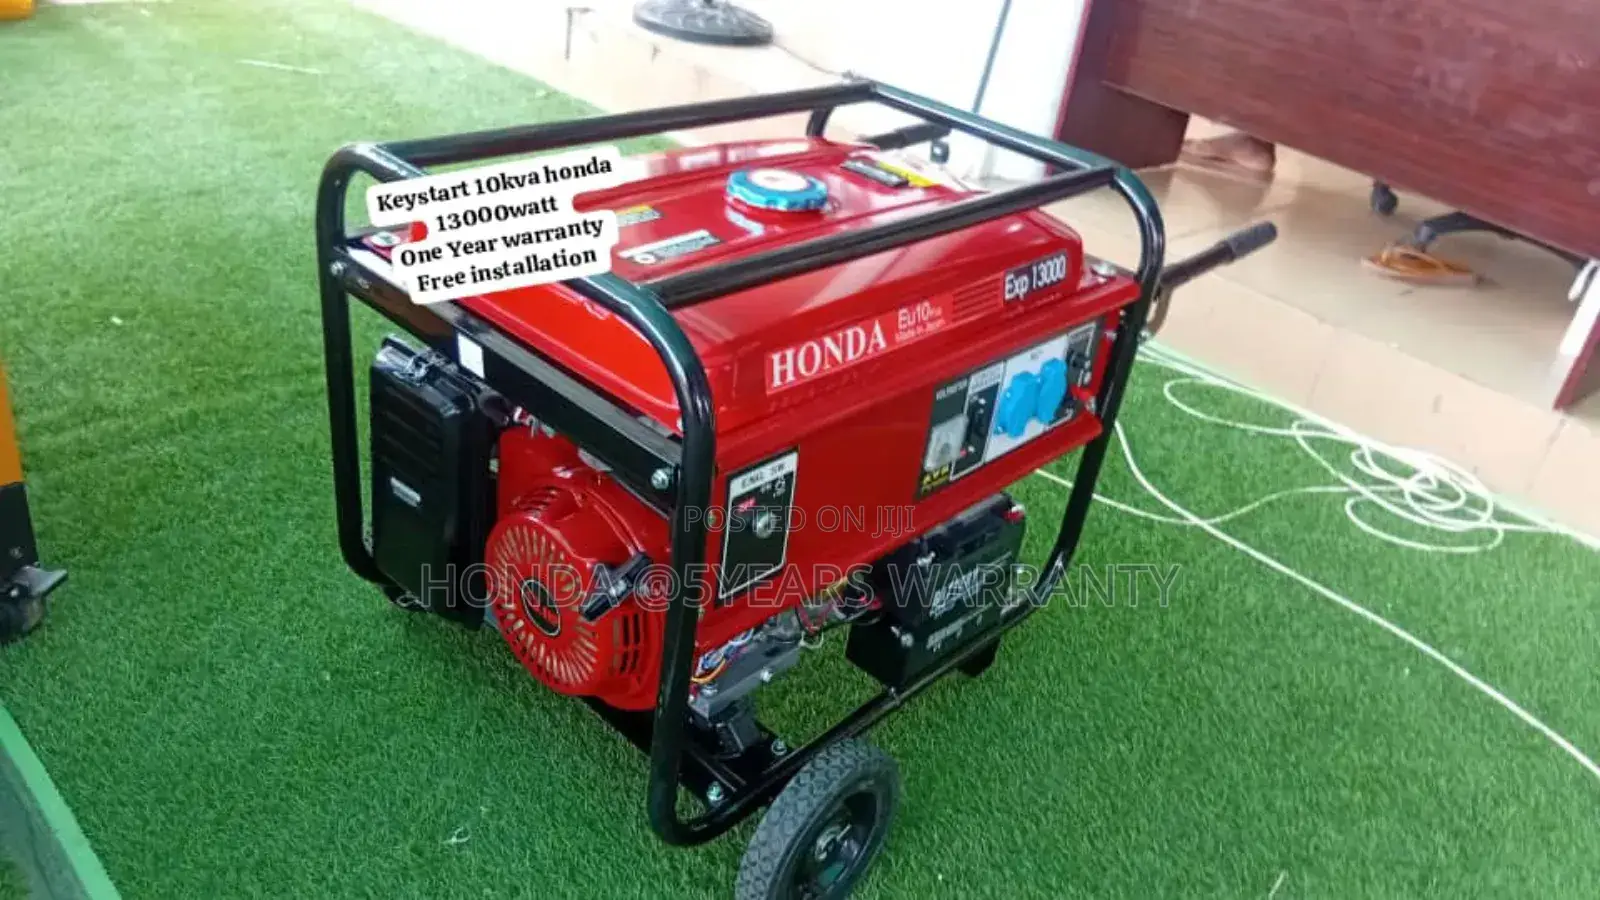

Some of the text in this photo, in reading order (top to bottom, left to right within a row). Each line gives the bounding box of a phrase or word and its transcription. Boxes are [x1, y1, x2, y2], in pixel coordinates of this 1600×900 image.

[1005, 254, 1067, 301] Exp 13000
[771, 319, 888, 388] HONDA
